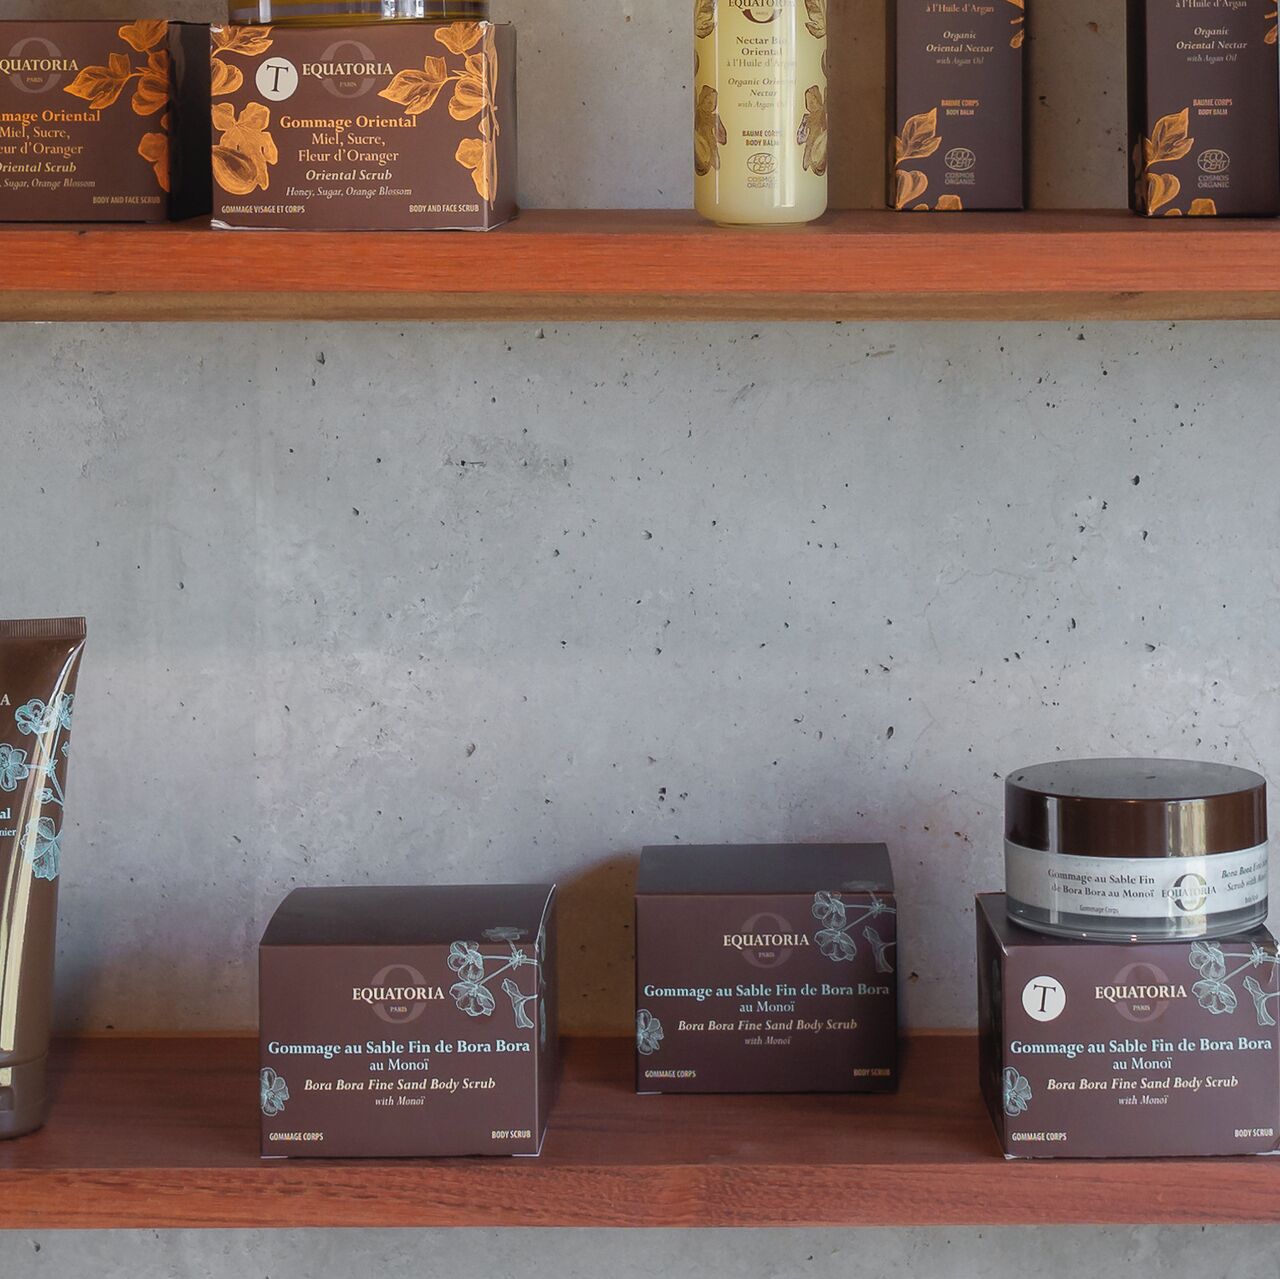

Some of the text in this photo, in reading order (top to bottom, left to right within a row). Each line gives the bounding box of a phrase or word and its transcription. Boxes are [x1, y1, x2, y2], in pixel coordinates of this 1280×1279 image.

[266, 65, 288, 92] T
[302, 63, 393, 79] EQUATORIA
[42, 110, 100, 122] Oriental
[280, 115, 416, 132] Gommage Oriental
[312, 133, 385, 146] Miel, Sucre,
[298, 149, 399, 166] Fleur d'Oranger
[44, 162, 76, 173] Scrub
[306, 170, 392, 181] Oriental Scrub
[286, 186, 412, 198] Honey, Sugar, Orange Blossom
[222, 205, 305, 214] GOMMAGE VISAGE ET CORPS
[409, 204, 479, 213] BODY AND FACE SCRUB
[1048, 869, 1155, 885] Gommage au Sable Fin
[723, 934, 810, 950] EQUATORIA
[352, 987, 444, 1004] EQUATORIA
[1034, 984, 1056, 1012] T
[1095, 986, 1187, 1002] EQUATORIA
[269, 1040, 530, 1058] Gommage au Sable Fin de Bora Bora
[1011, 1038, 1272, 1058] Gommage au Sable Fin de Bora Bora
[370, 1058, 429, 1071] au Monoï
[304, 1078, 495, 1093] Bora Bora Fine Sand Body Scrub
[492, 1130, 531, 1139] BODY SCRUB
